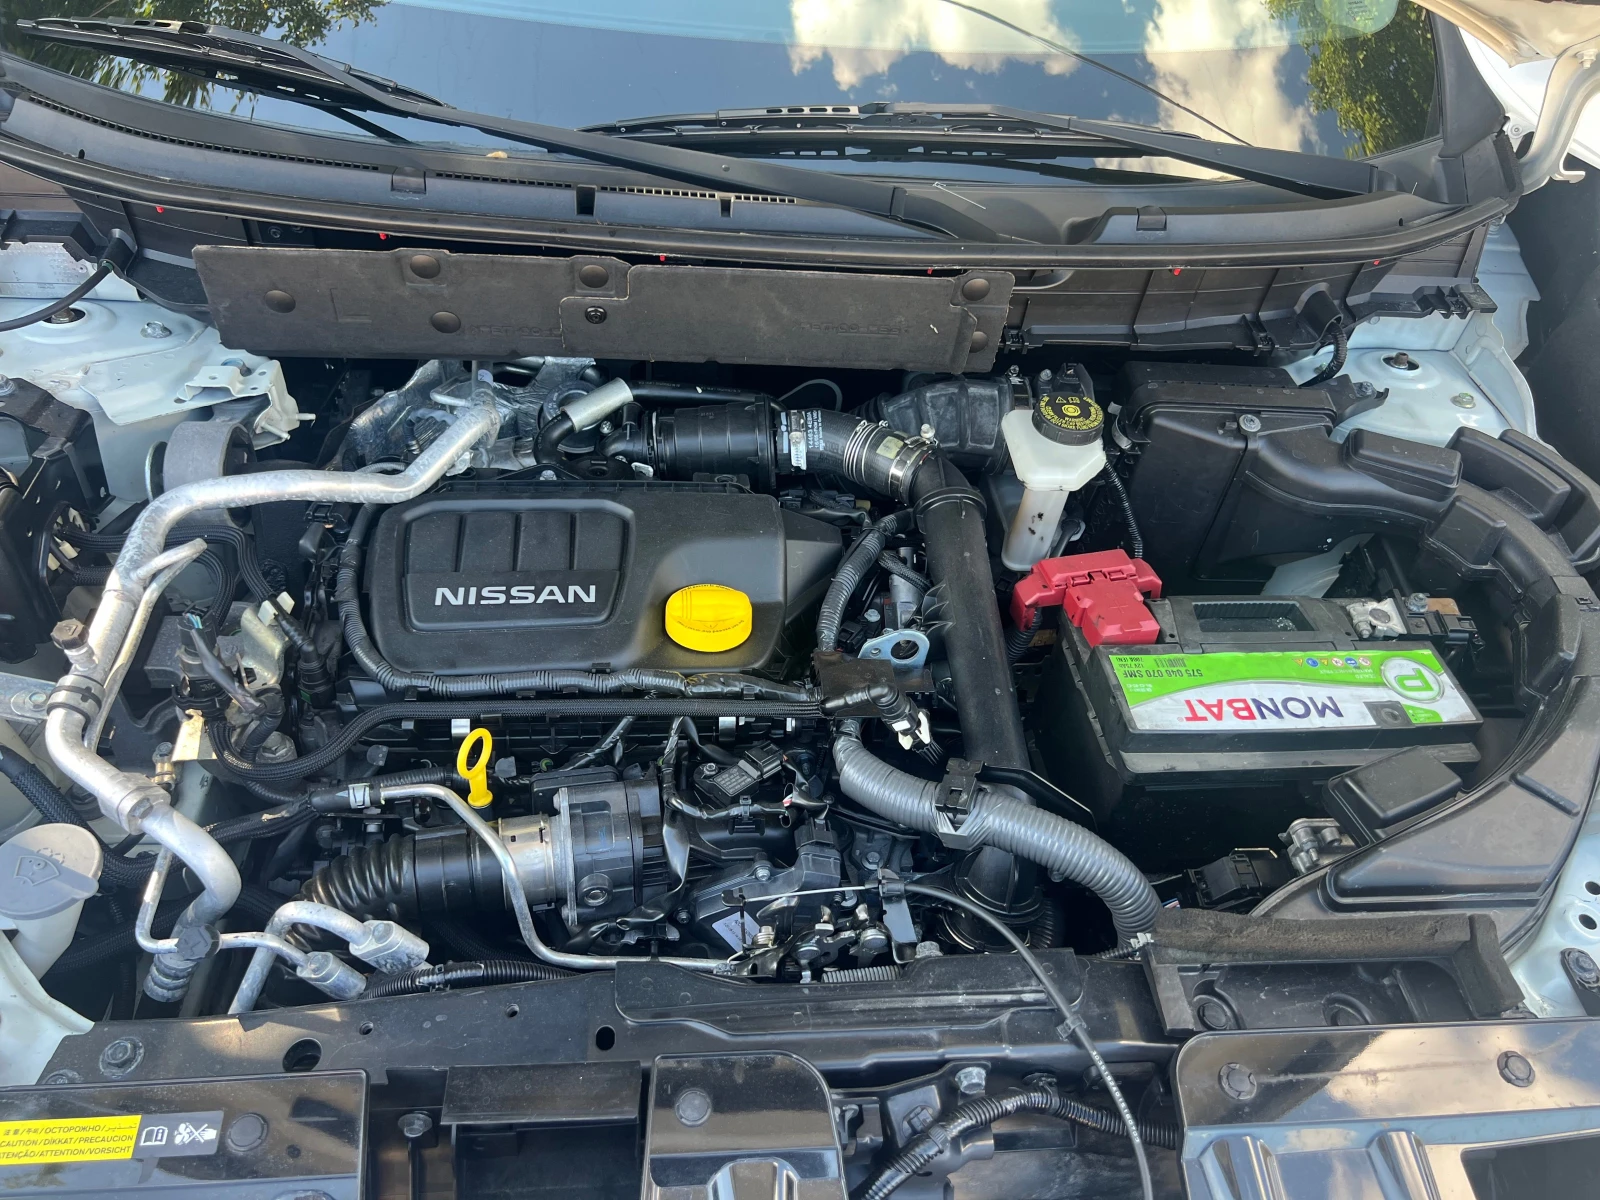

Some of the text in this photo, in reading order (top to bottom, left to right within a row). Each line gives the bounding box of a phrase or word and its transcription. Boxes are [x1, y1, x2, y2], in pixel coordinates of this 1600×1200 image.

[434, 585, 596, 606] NISSAN
[1122, 670, 1143, 678] SMF
[1185, 669, 1203, 677] 575
[1184, 696, 1344, 722] MONBAT
